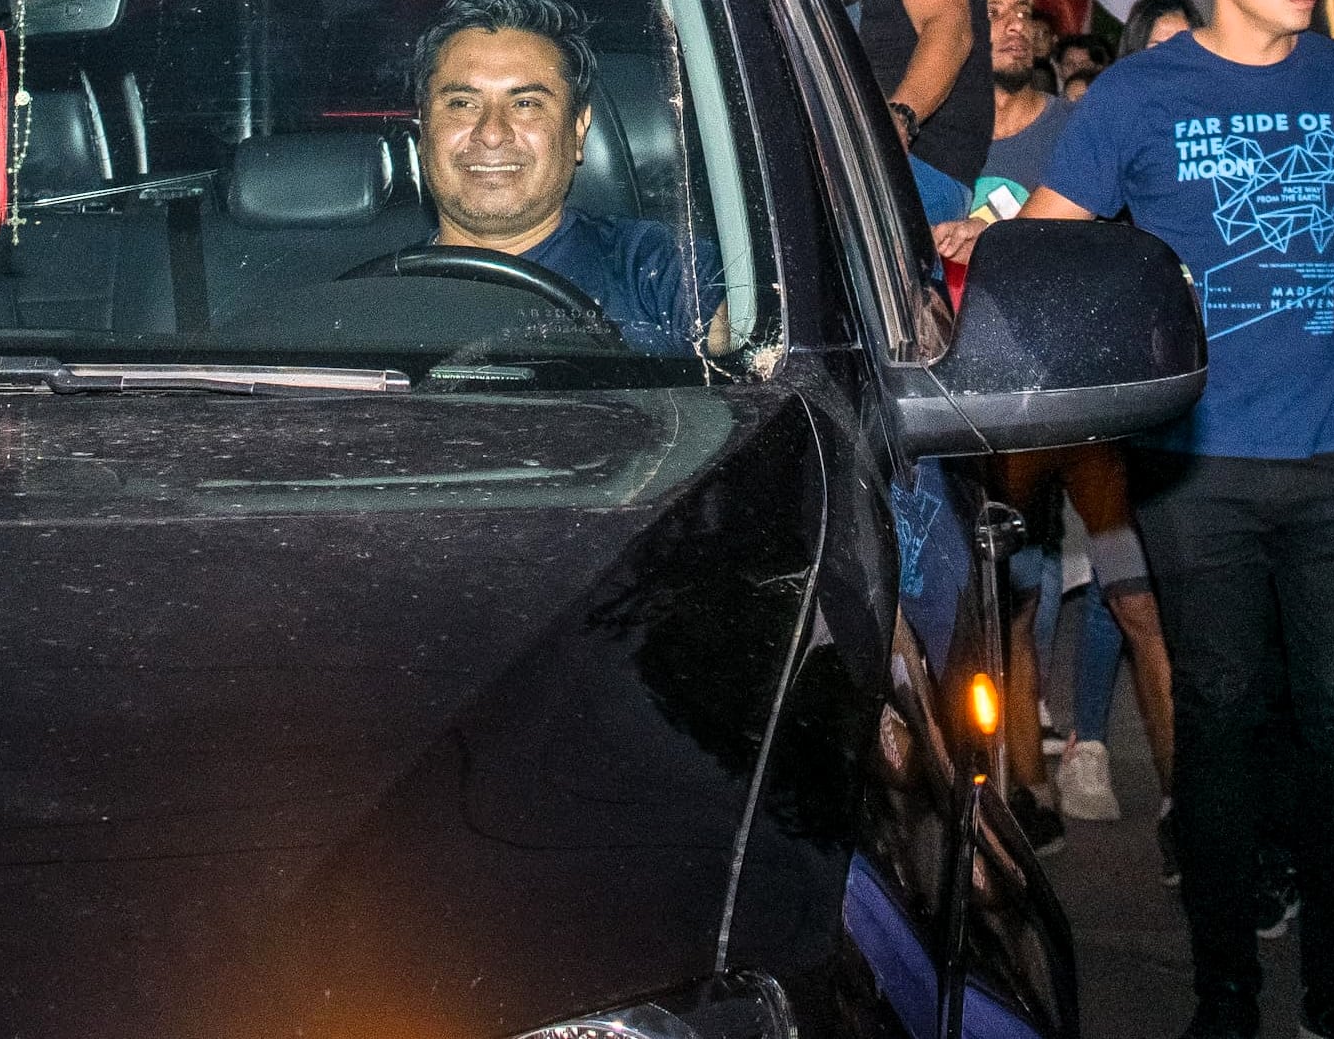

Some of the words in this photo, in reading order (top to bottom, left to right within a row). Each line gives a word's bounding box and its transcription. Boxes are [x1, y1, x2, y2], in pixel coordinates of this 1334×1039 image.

[1175, 117, 1221, 139] FAR
[1231, 114, 1289, 133] SIDE
[1298, 113, 1332, 131] OF
[1176, 137, 1224, 160] THE
[1178, 158, 1255, 182] MOON
[1272, 286, 1314, 297] MADE
[1270, 299, 1334, 309] HEAVEN
